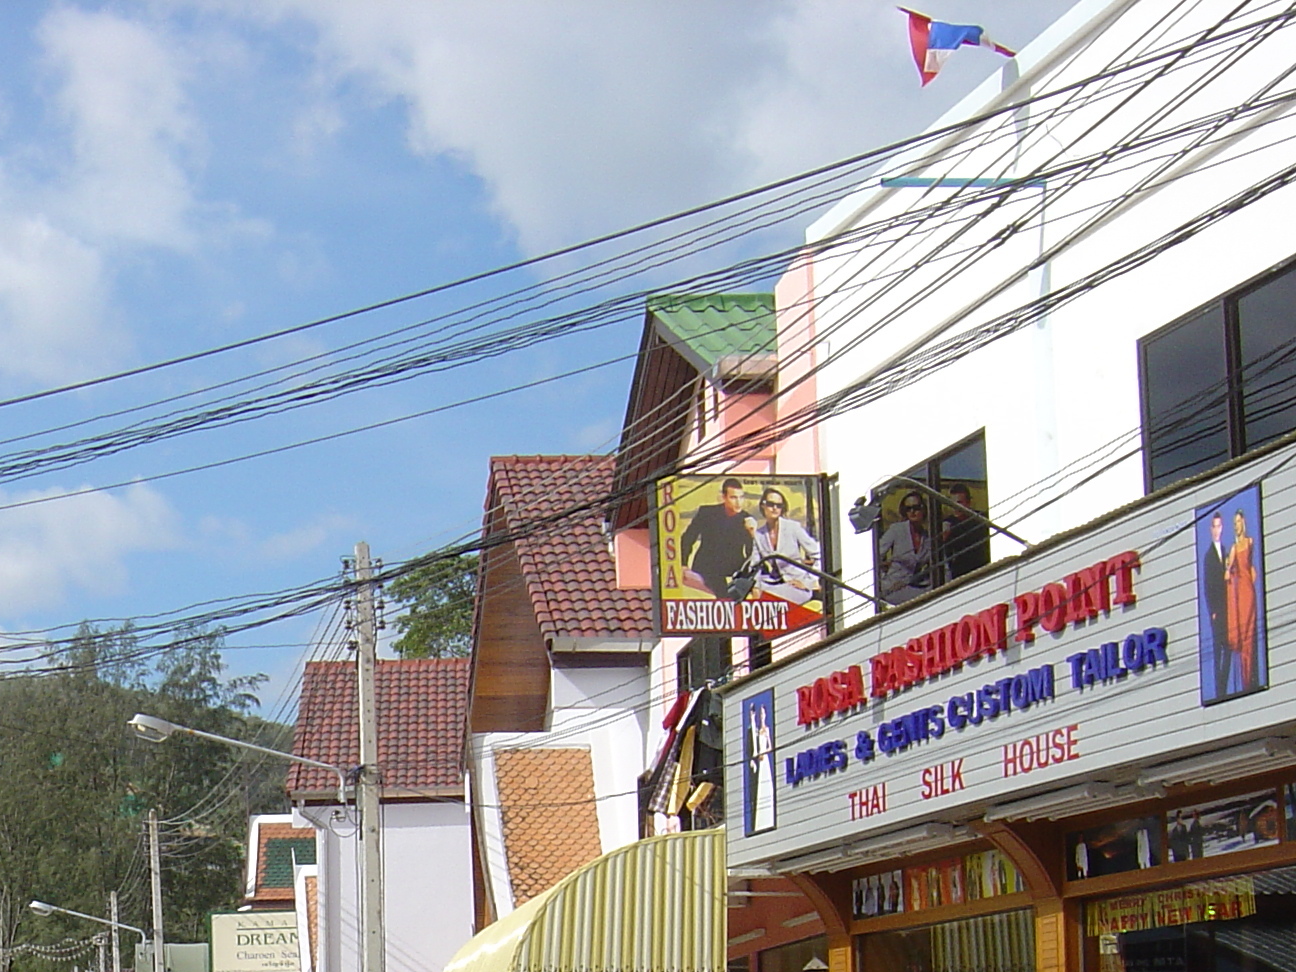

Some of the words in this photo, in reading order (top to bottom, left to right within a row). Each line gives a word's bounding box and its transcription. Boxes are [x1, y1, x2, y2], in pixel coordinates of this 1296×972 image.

[663, 482, 678, 589] ROSA
[666, 601, 735, 630] FASHION
[742, 601, 788, 630] POINT
[796, 664, 867, 727] ROSA
[870, 602, 1009, 698] FASHION
[1014, 550, 1141, 643] POINT
[785, 740, 848, 786] LADIES
[855, 730, 874, 761] &
[877, 705, 945, 754] GENTS
[947, 664, 1055, 730] CUSTOM
[1066, 627, 1168, 689] TAILOR
[849, 783, 887, 821] THAI
[921, 758, 965, 799] SILK
[1003, 724, 1079, 777] HOUSE
[238, 920, 298, 928] KAMA
[1099, 912, 1148, 932] HAPPY
[1157, 907, 1192, 926] NEW
[1199, 901, 1243, 921] YEAR
[236, 951, 275, 960] Charoen
[281, 951, 301, 959] Sea
